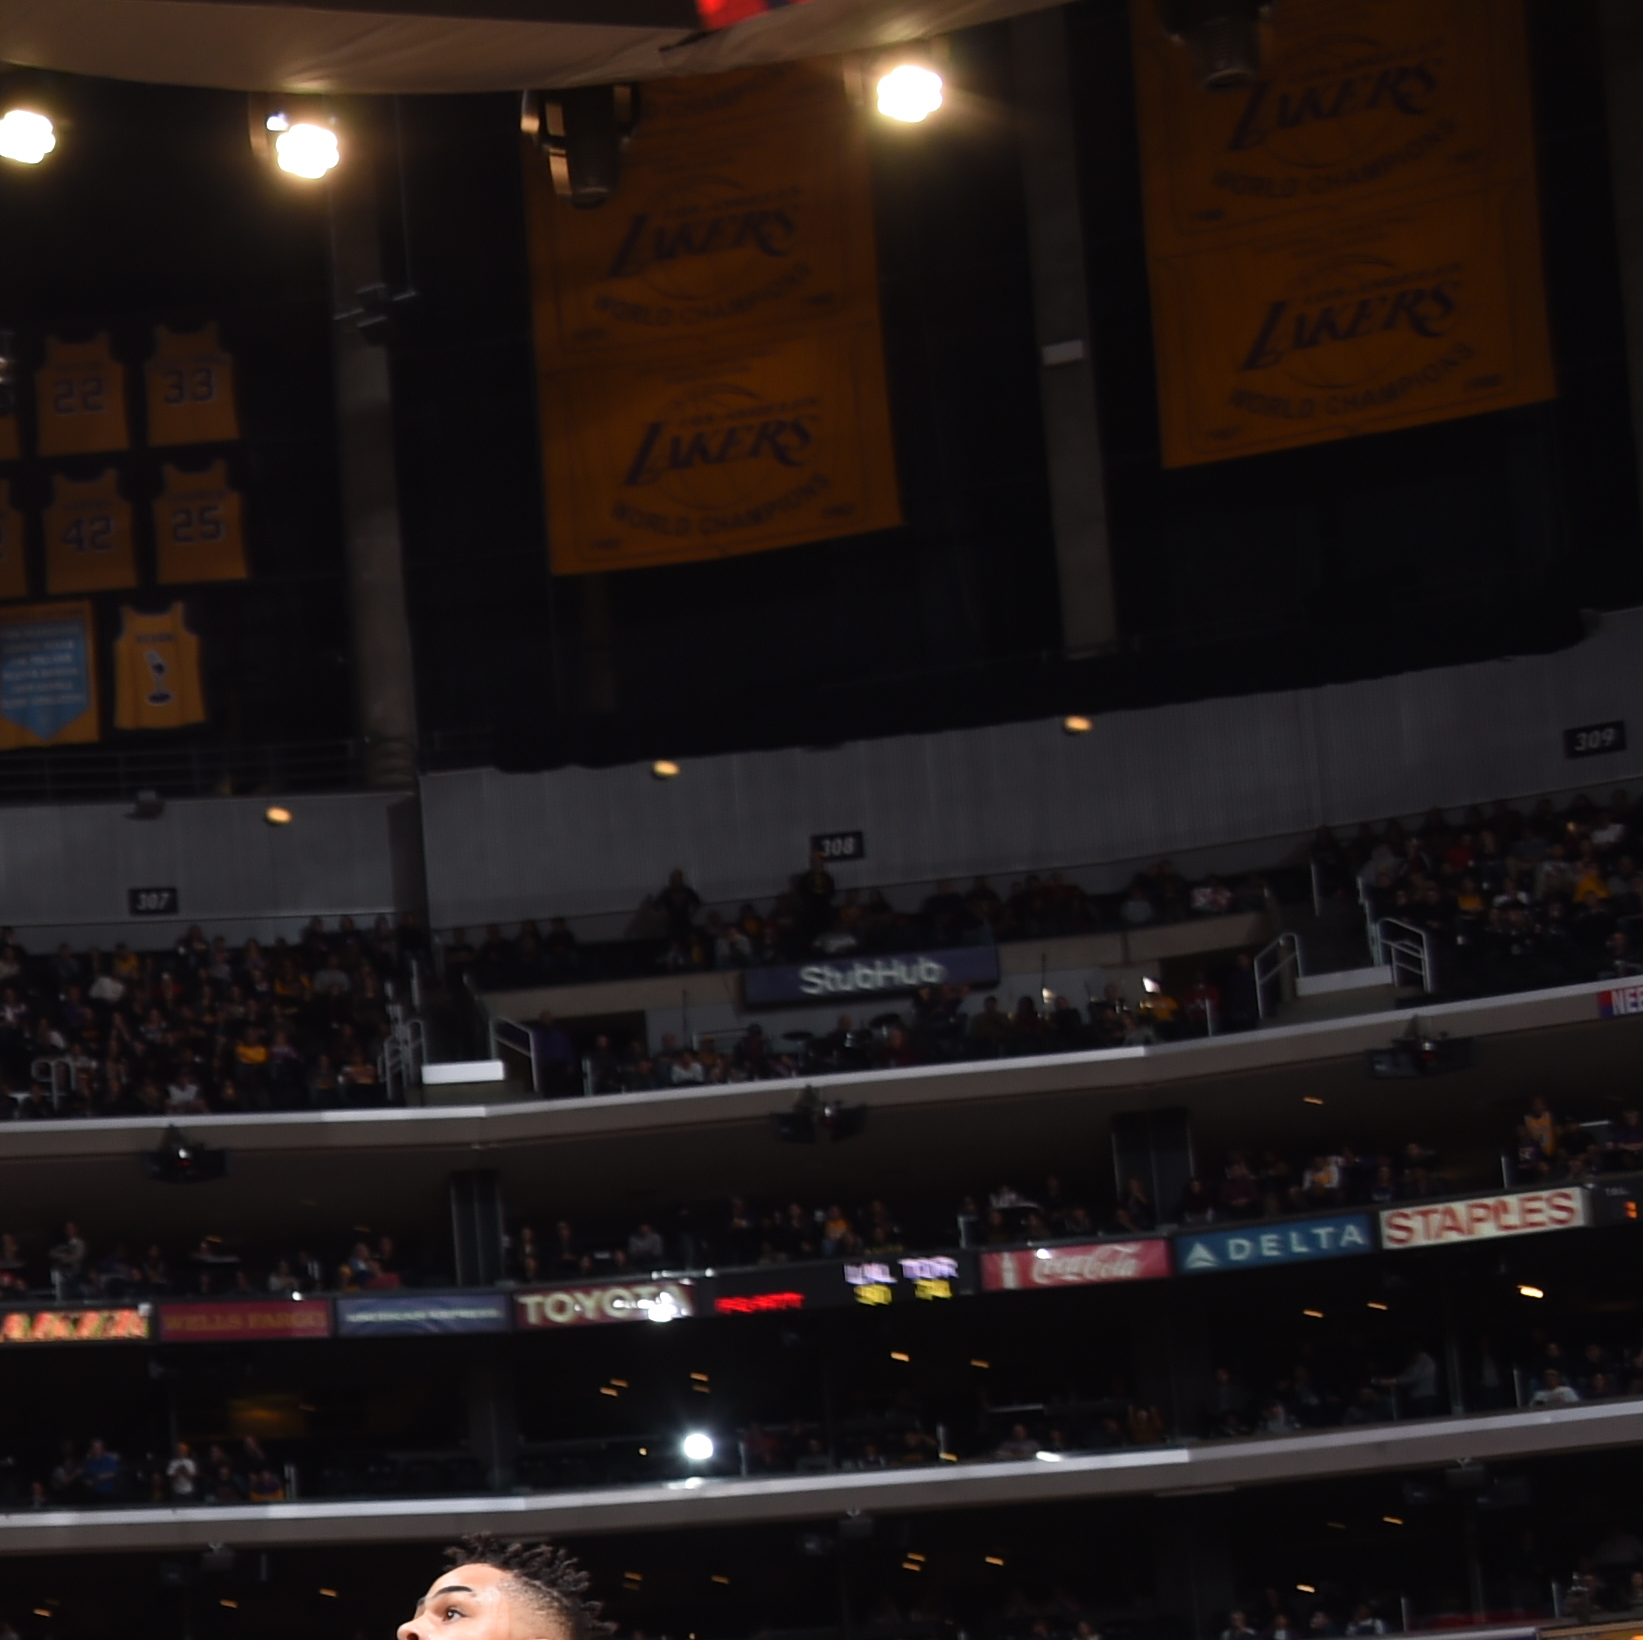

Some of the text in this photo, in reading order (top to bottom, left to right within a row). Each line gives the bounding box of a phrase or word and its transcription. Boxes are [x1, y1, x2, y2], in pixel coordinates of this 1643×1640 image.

[1238, 280, 1465, 372] LAKERS
[53, 375, 105, 414] 22
[165, 366, 215, 404] 33
[621, 417, 817, 489] LAKERS
[62, 514, 113, 552] 42
[172, 505, 223, 543] 25
[799, 957, 947, 996] StubHub
[1385, 1190, 1580, 1249] STAPLES
[1228, 1224, 1367, 1261] DELTA
[1031, 1242, 1142, 1285] Coca-Cola
